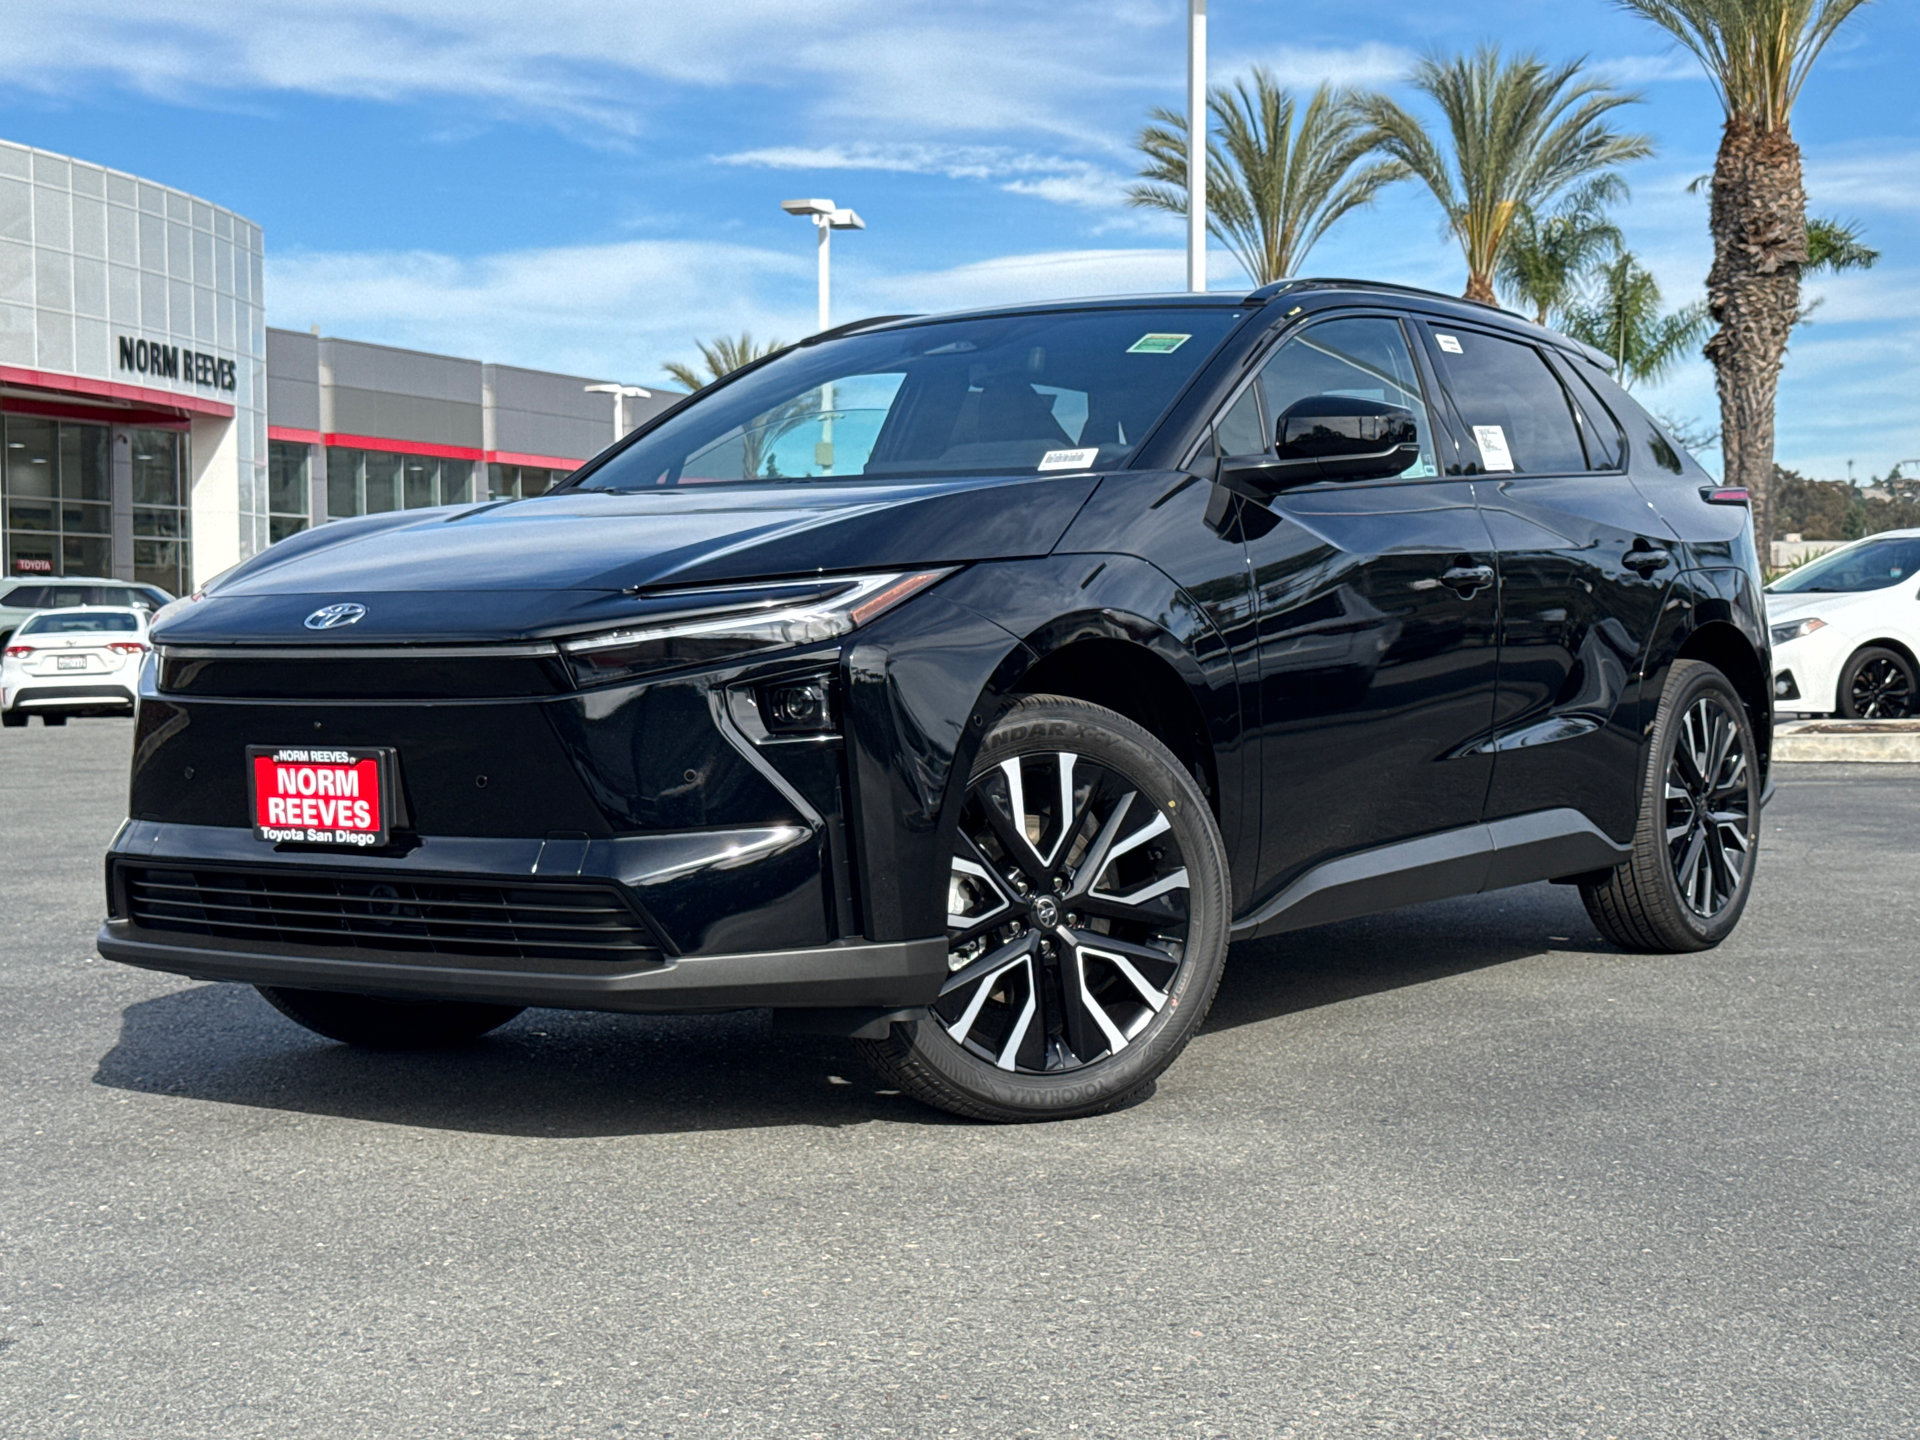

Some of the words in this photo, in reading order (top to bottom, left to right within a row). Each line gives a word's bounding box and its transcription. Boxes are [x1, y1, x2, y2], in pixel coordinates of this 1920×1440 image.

[118, 335, 178, 379] NORM
[182, 348, 236, 391] REEVES
[20, 559, 51, 571] TOYOTA
[278, 750, 309, 762] NORM
[310, 751, 349, 763] REEVES
[277, 767, 359, 797] NORM
[268, 797, 371, 828] REEVES
[260, 826, 304, 842] Toyota
[307, 829, 332, 842] San
[336, 830, 375, 846] Diego
[1008, 1079, 1111, 1106] YOKOHAMA
